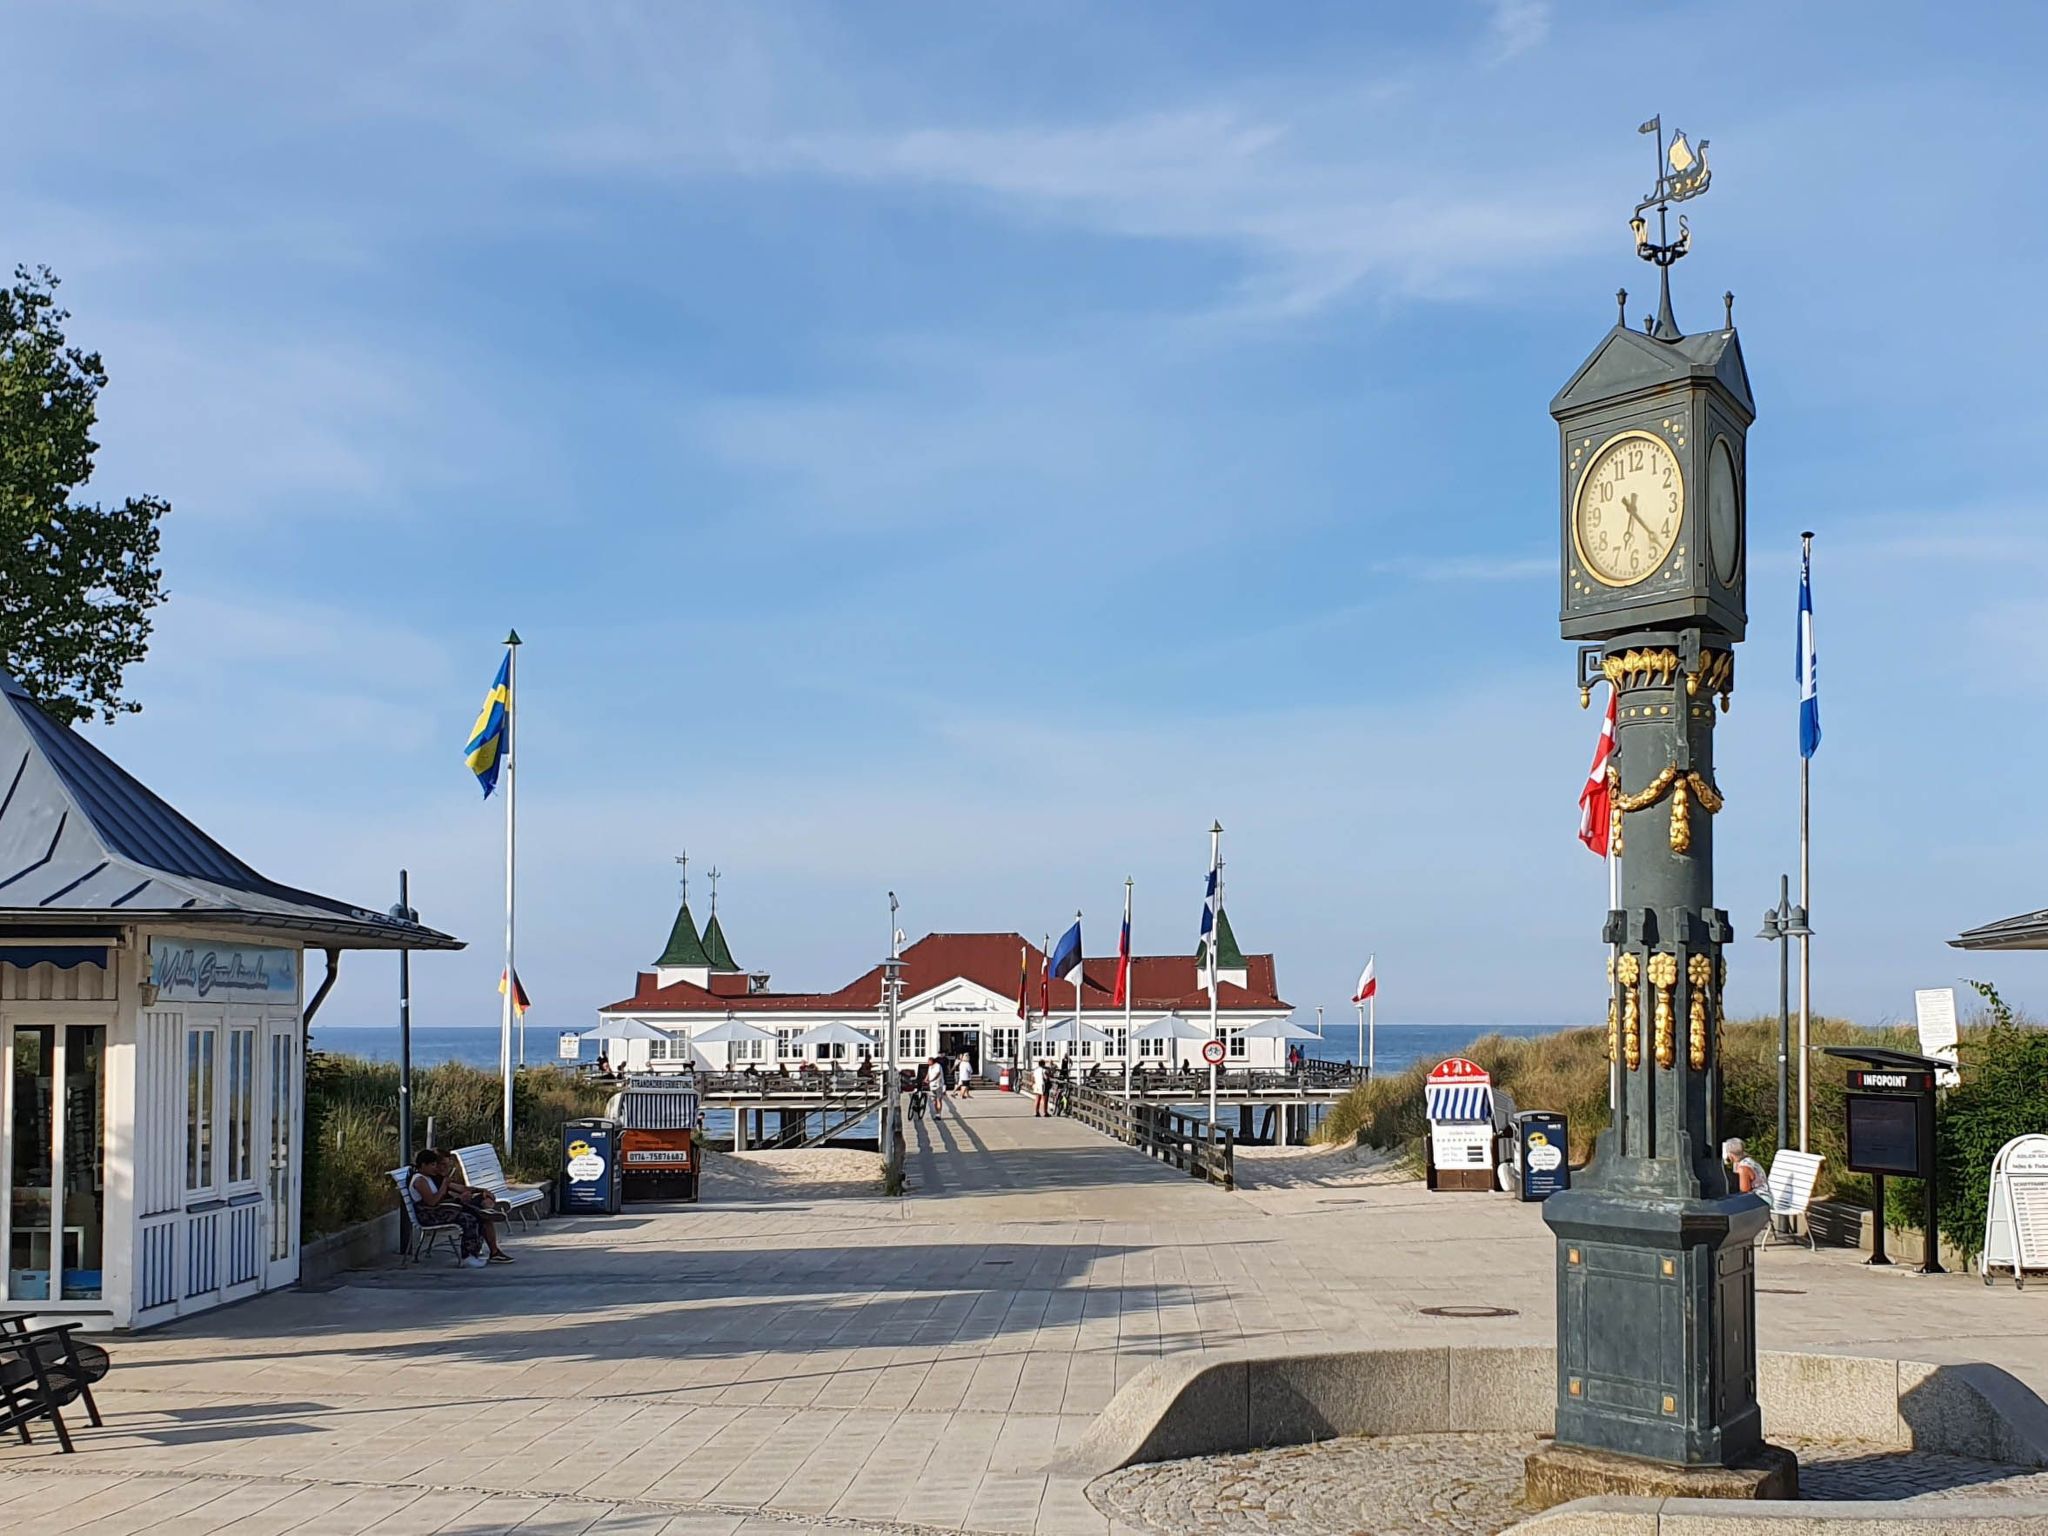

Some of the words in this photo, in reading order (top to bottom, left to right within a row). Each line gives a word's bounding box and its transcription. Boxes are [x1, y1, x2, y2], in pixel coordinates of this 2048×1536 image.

[1614, 459, 1626, 482] 11
[1628, 449, 1644, 473] 12
[1651, 453, 1658, 476] 1
[1663, 467, 1672, 490] 2
[1599, 481, 1614, 504] 10
[1669, 491, 1678, 514] 3
[1592, 507, 1602, 528] 9
[1661, 517, 1671, 539] 4
[1599, 530, 1608, 552] 8
[1612, 546, 1621, 568] 7
[1630, 548, 1640, 570] 6
[1863, 1074, 1908, 1088] INFOPOINT
